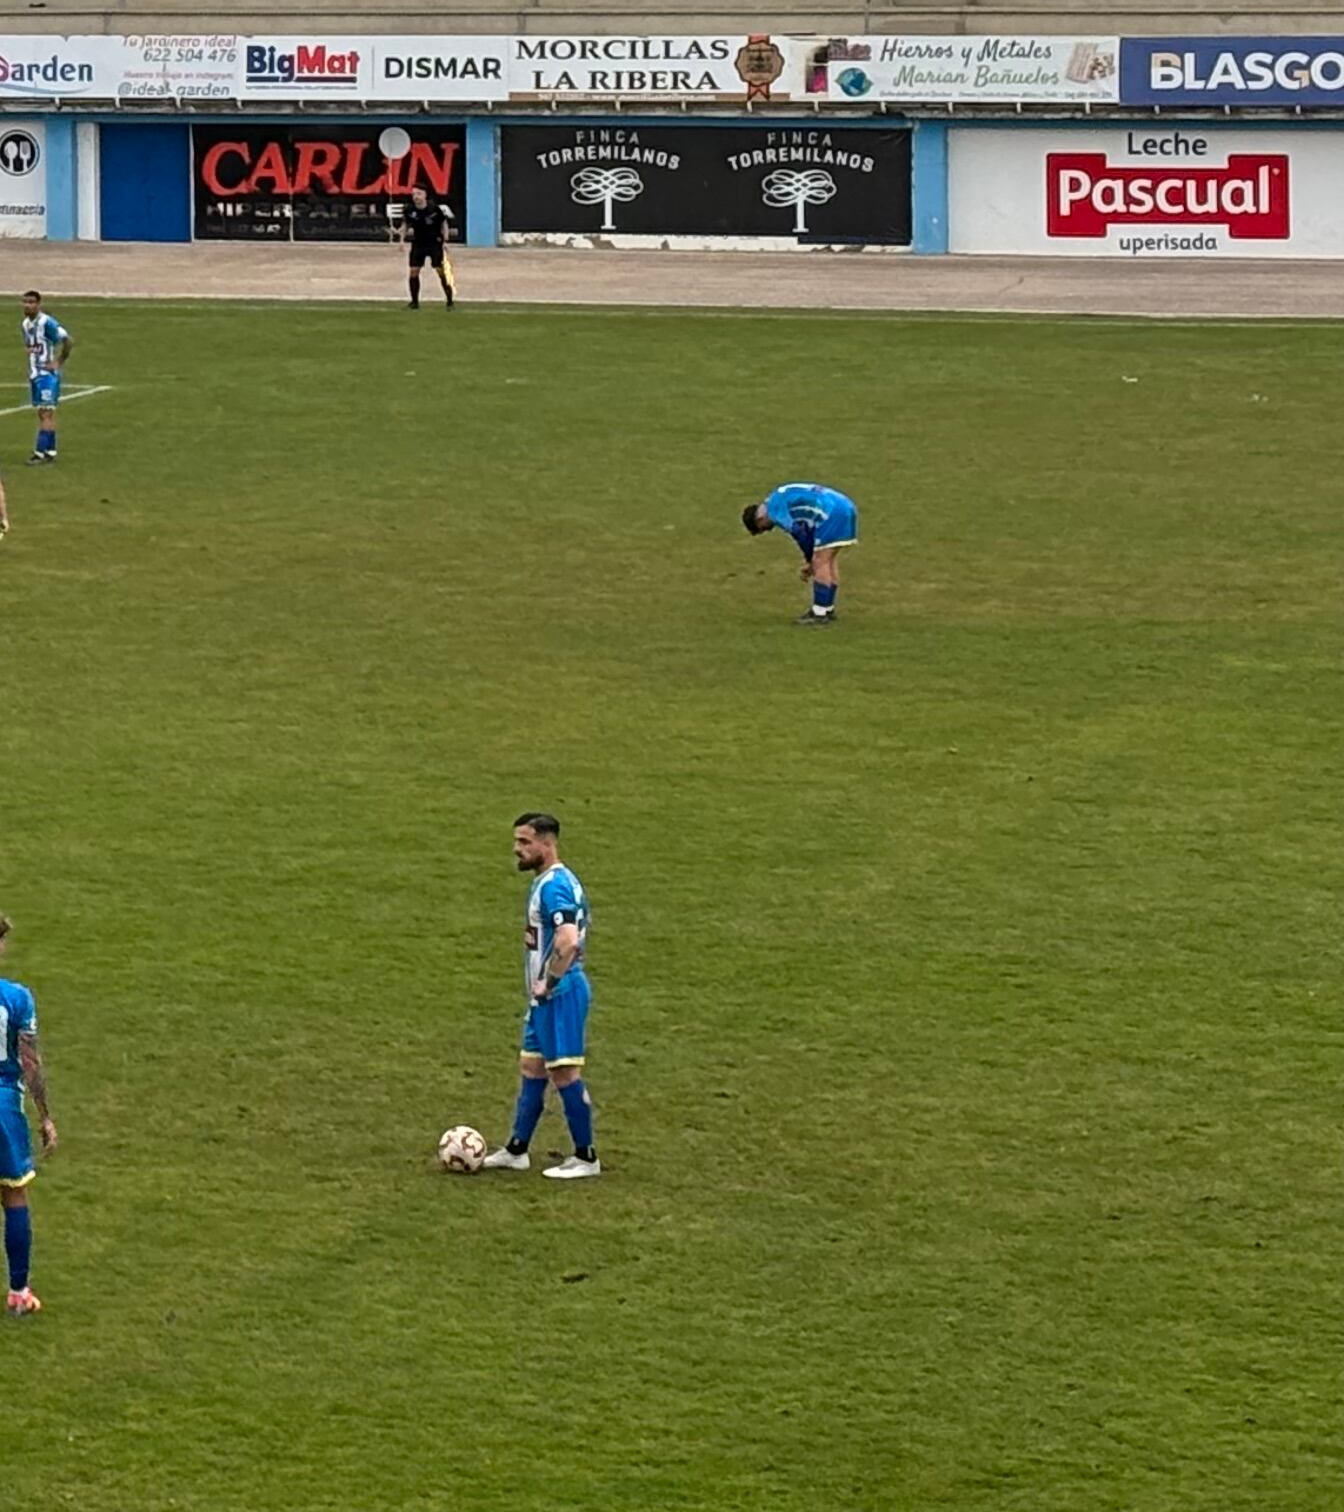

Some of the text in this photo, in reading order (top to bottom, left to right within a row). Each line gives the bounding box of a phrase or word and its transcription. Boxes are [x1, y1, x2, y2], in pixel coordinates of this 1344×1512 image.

[204, 35, 237, 47] ideal
[515, 39, 730, 60] MORCILLAS
[143, 48, 237, 62] 622 504 476
[246, 45, 360, 82] BigMat
[880, 38, 1053, 67] Hierros y Metales
[384, 57, 502, 80] DISMAR
[893, 65, 1060, 87] Marian Bañuelos
[532, 70, 721, 90] LA RIBERA
[575, 130, 640, 144] FINCA
[767, 131, 833, 146] FINCA
[1127, 132, 1208, 156] Leche
[536, 145, 681, 170] TORREMILANOS
[727, 147, 875, 172] TORREMILANOS
[1057, 164, 1270, 217] Pascual
[1119, 233, 1218, 255] uperisada
